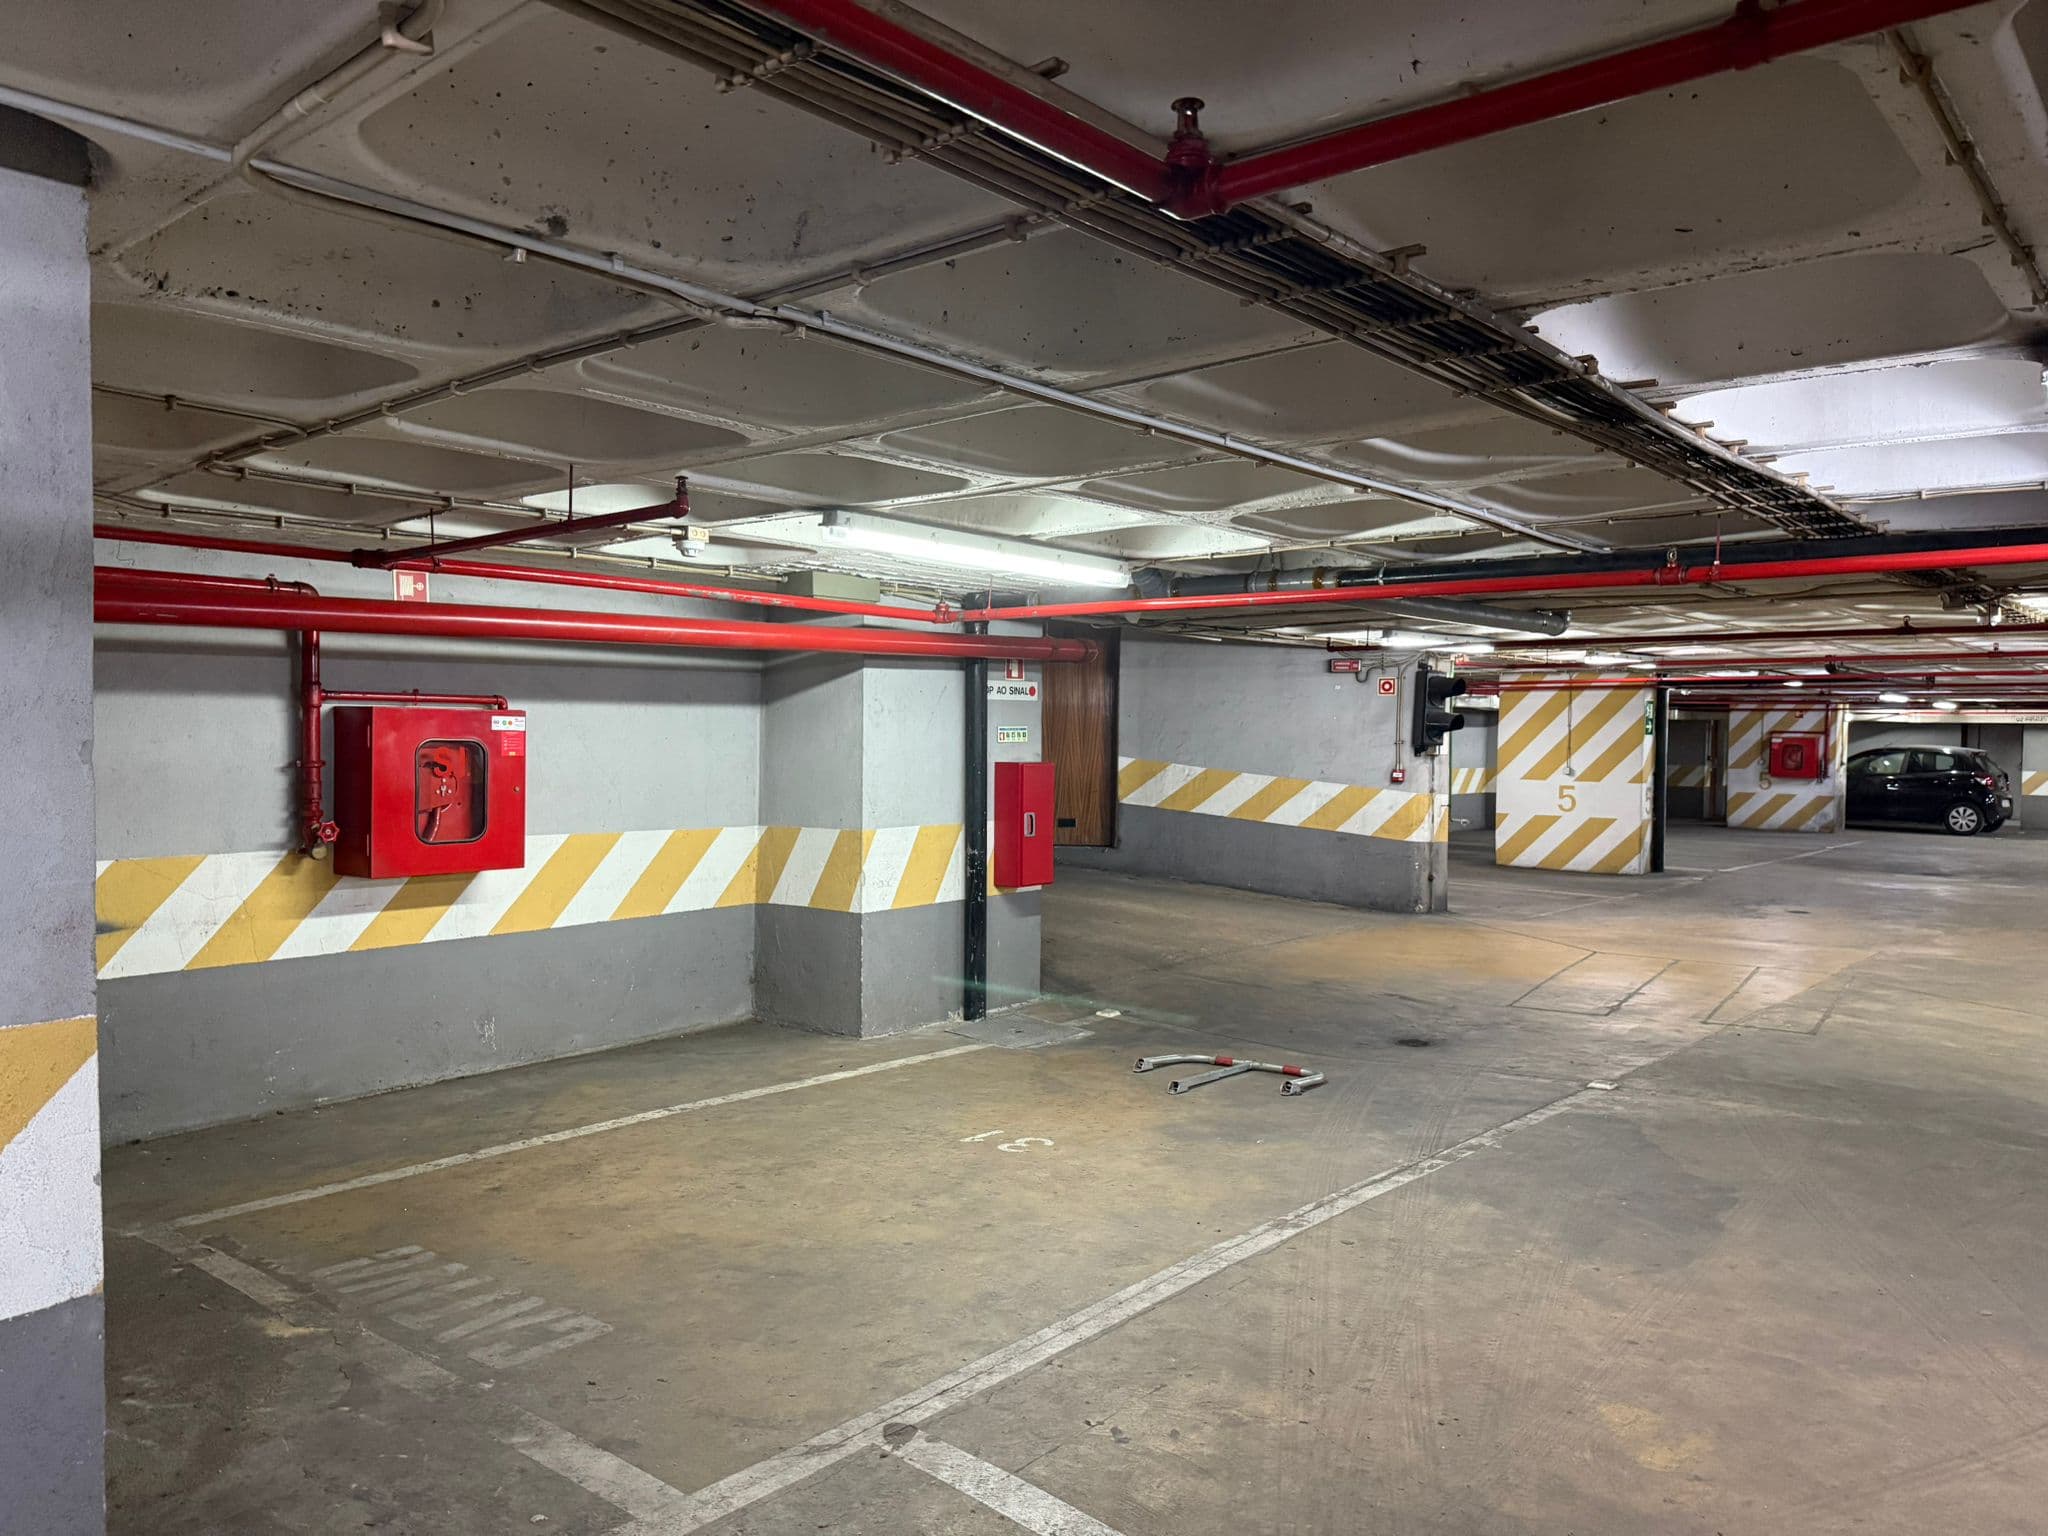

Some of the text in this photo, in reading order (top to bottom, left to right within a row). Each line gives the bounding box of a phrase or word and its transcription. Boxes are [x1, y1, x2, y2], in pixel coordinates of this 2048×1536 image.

[997, 686, 1006, 695] AO
[1009, 686, 1029, 696] SINAL
[1557, 785, 1577, 813] 5
